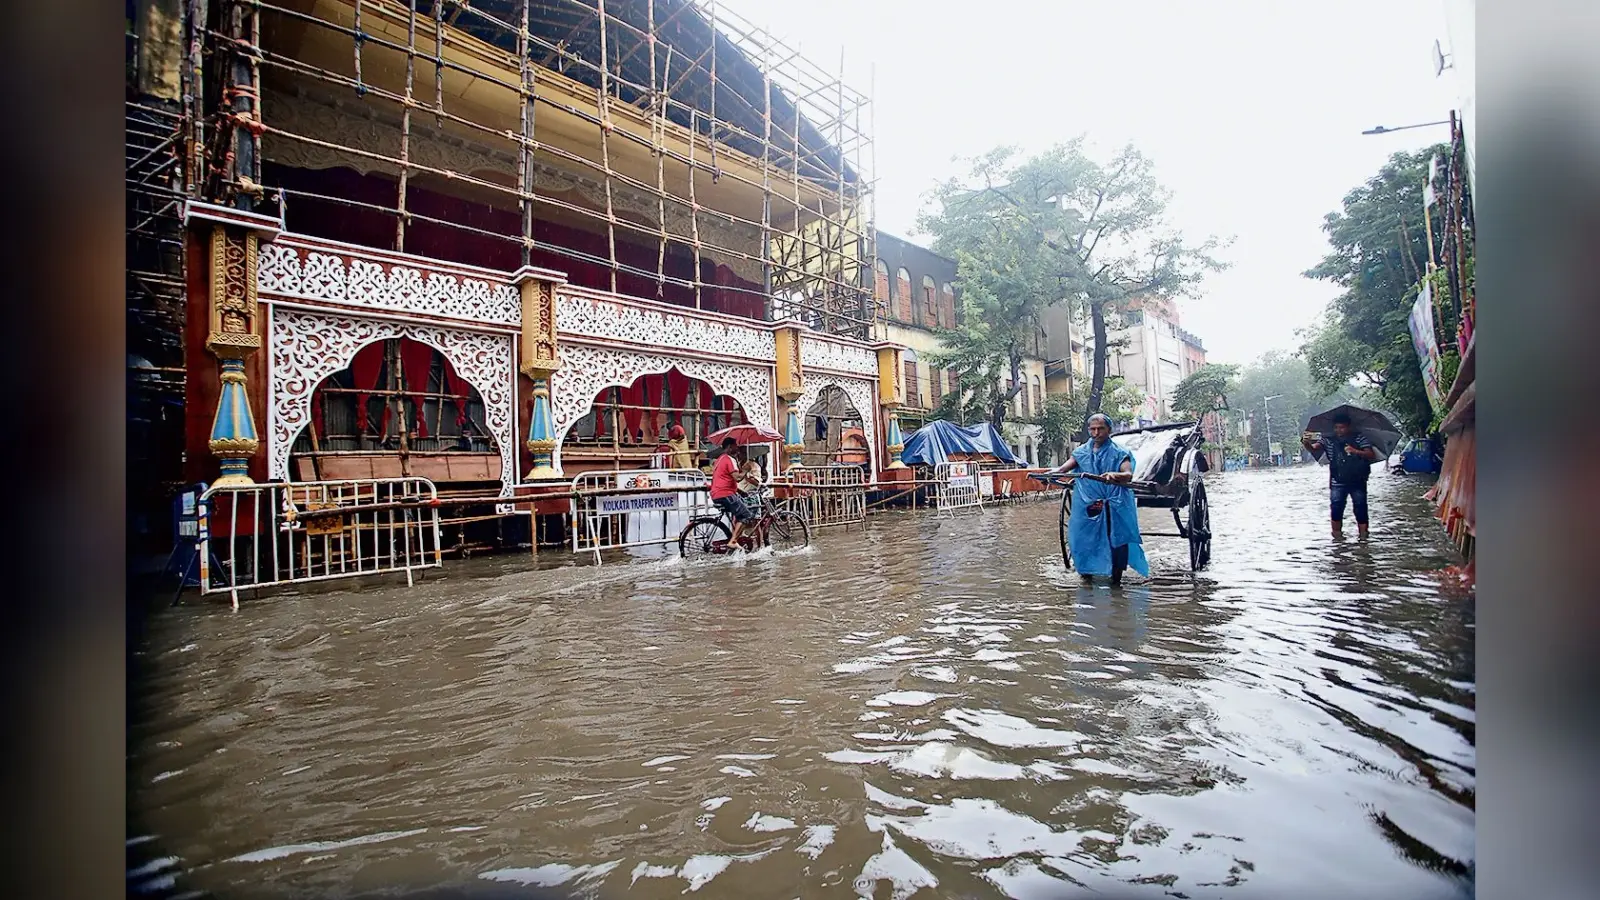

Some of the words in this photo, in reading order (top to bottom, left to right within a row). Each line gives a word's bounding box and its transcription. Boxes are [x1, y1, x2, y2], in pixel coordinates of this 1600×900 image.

[603, 500, 631, 511] KOLKATA
[631, 499, 654, 509] TRAFFIC
[655, 497, 674, 507] POLICE
